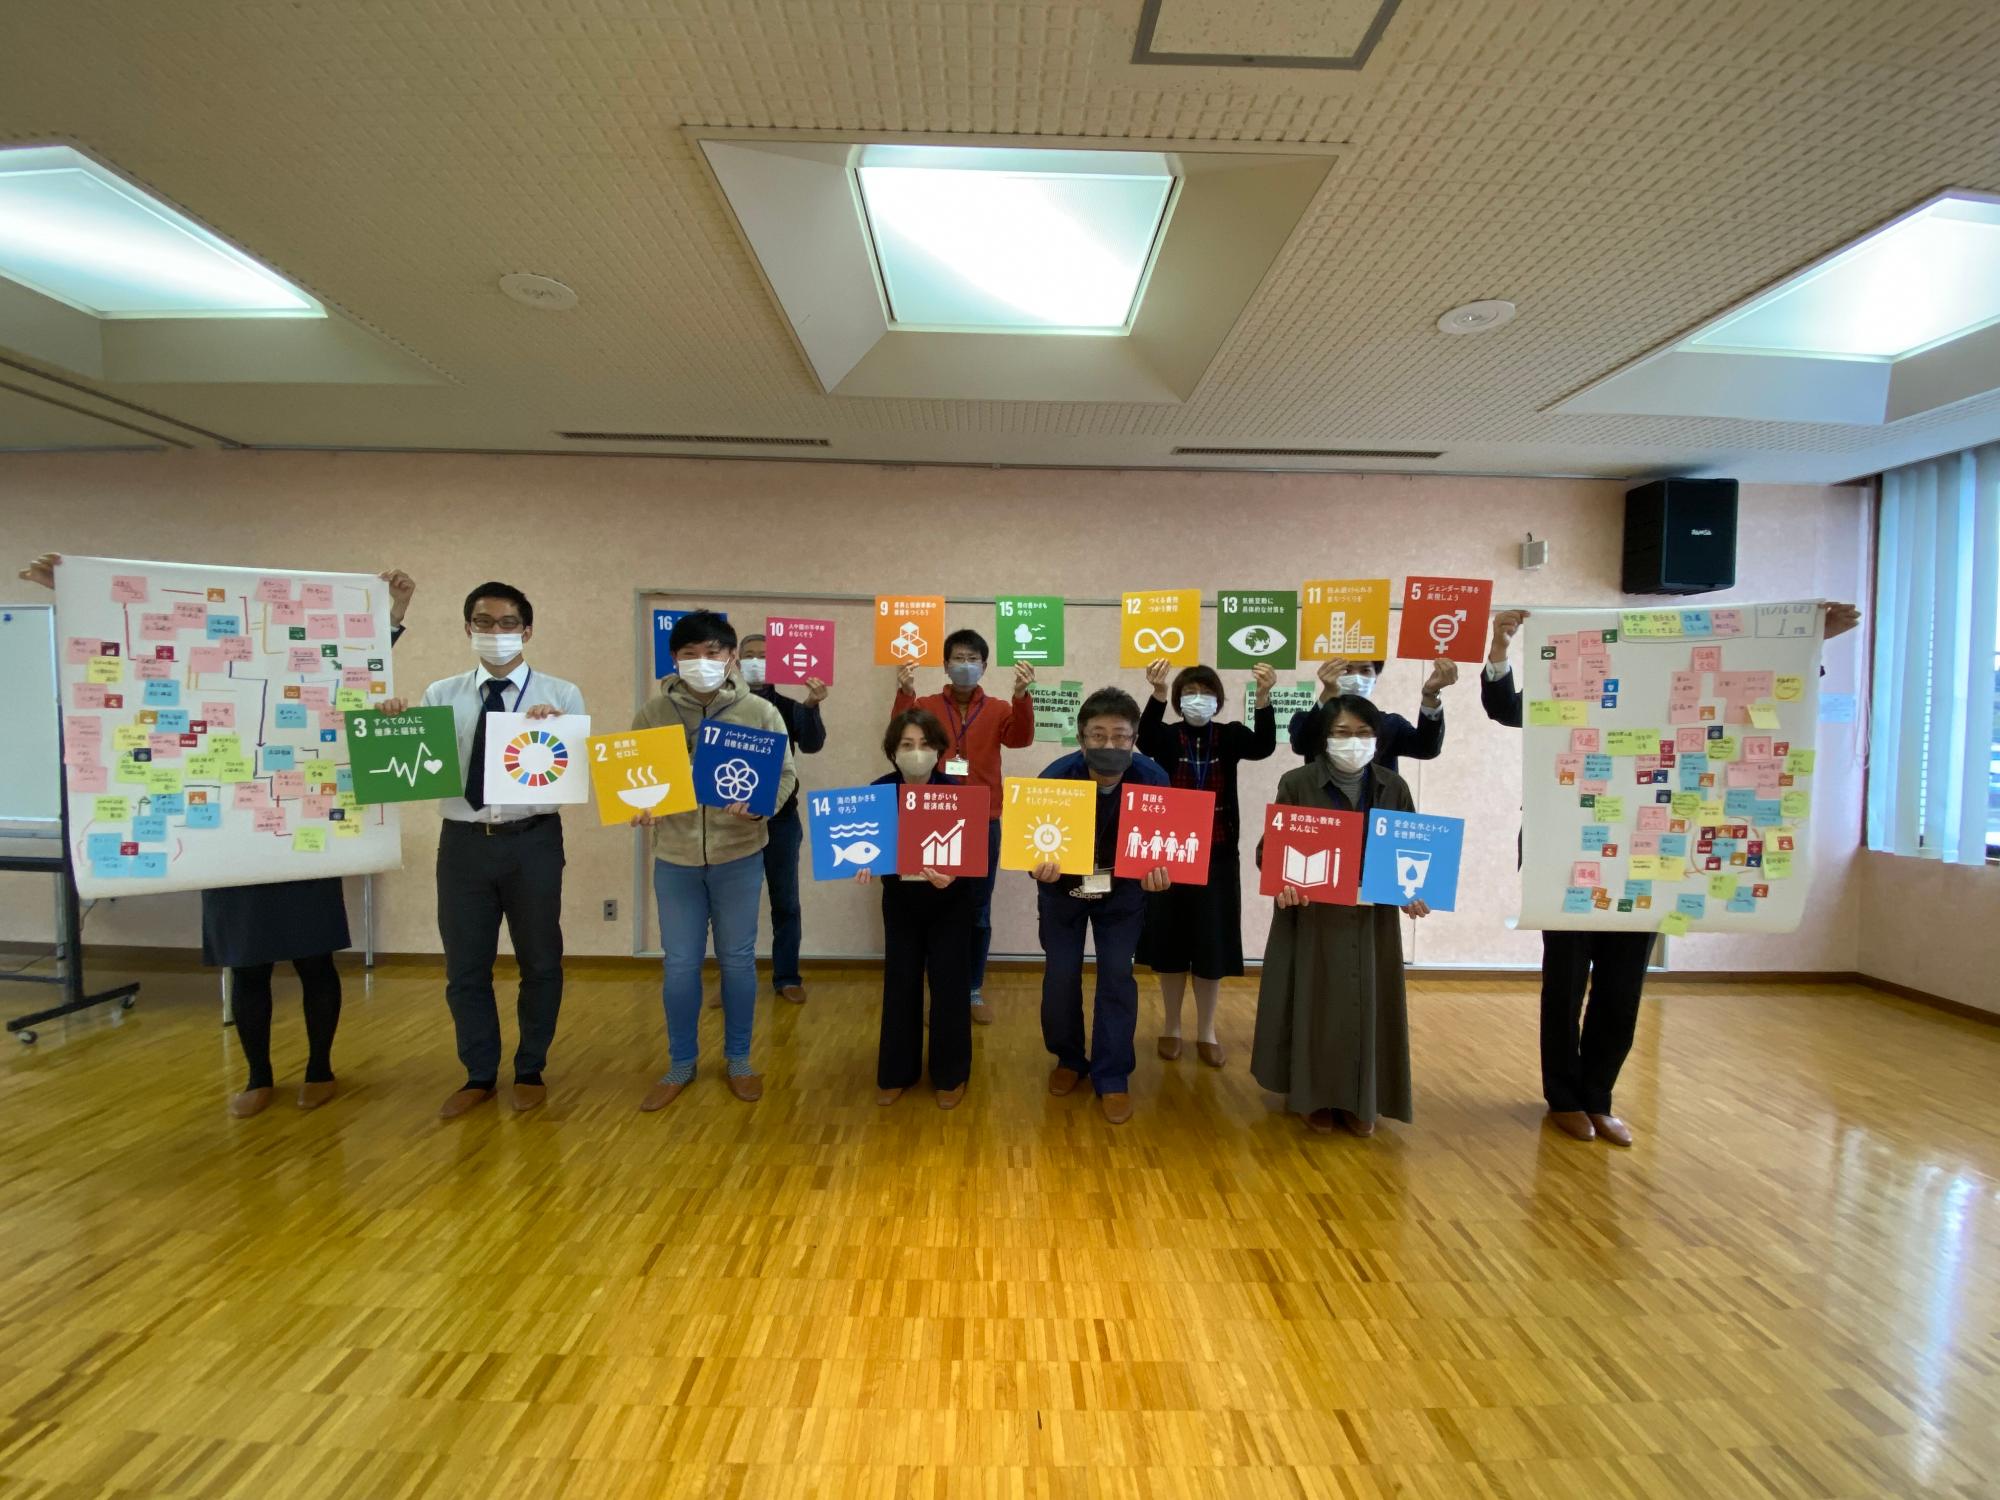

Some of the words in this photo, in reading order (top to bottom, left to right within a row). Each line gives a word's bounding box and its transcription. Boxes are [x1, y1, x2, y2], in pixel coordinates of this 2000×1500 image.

[1307, 587, 1321, 604] 11
[1411, 583, 1422, 600] 5
[880, 601, 888, 616] 9
[999, 601, 1014, 617] 15
[1126, 598, 1141, 614] 12
[1221, 596, 1239, 613] 13
[657, 615, 673, 631] 16
[769, 622, 784, 637] 10
[353, 717, 368, 737] 3
[374, 716, 423, 726] すべての人に
[374, 726, 426, 737] 健康と福祉を
[703, 726, 721, 745] 17
[725, 730, 776, 744] パートナーシップで
[594, 743, 608, 762] 2
[616, 749, 639, 759] ゼロに
[724, 738, 772, 755] 目標を達成しよう
[837, 793, 876, 805] 海の豊かさを
[905, 791, 916, 811] 8
[923, 792, 958, 801] 働きがいも
[1011, 784, 1020, 804] 7
[1126, 791, 1135, 811] 1
[1142, 793, 1164, 804] 貧困を
[812, 796, 831, 817] 14
[838, 805, 857, 815] 守ろう
[923, 802, 958, 811] 経済成長も
[1140, 803, 1167, 814] なくそう
[1271, 811, 1284, 831] 4
[1290, 813, 1342, 827] 質の高い教育を
[1375, 817, 1388, 837] 6
[1393, 819, 1450, 833] 安全な水とトイレ
[1289, 824, 1319, 834] みんなに
[1393, 830, 1431, 842] を世界中に
